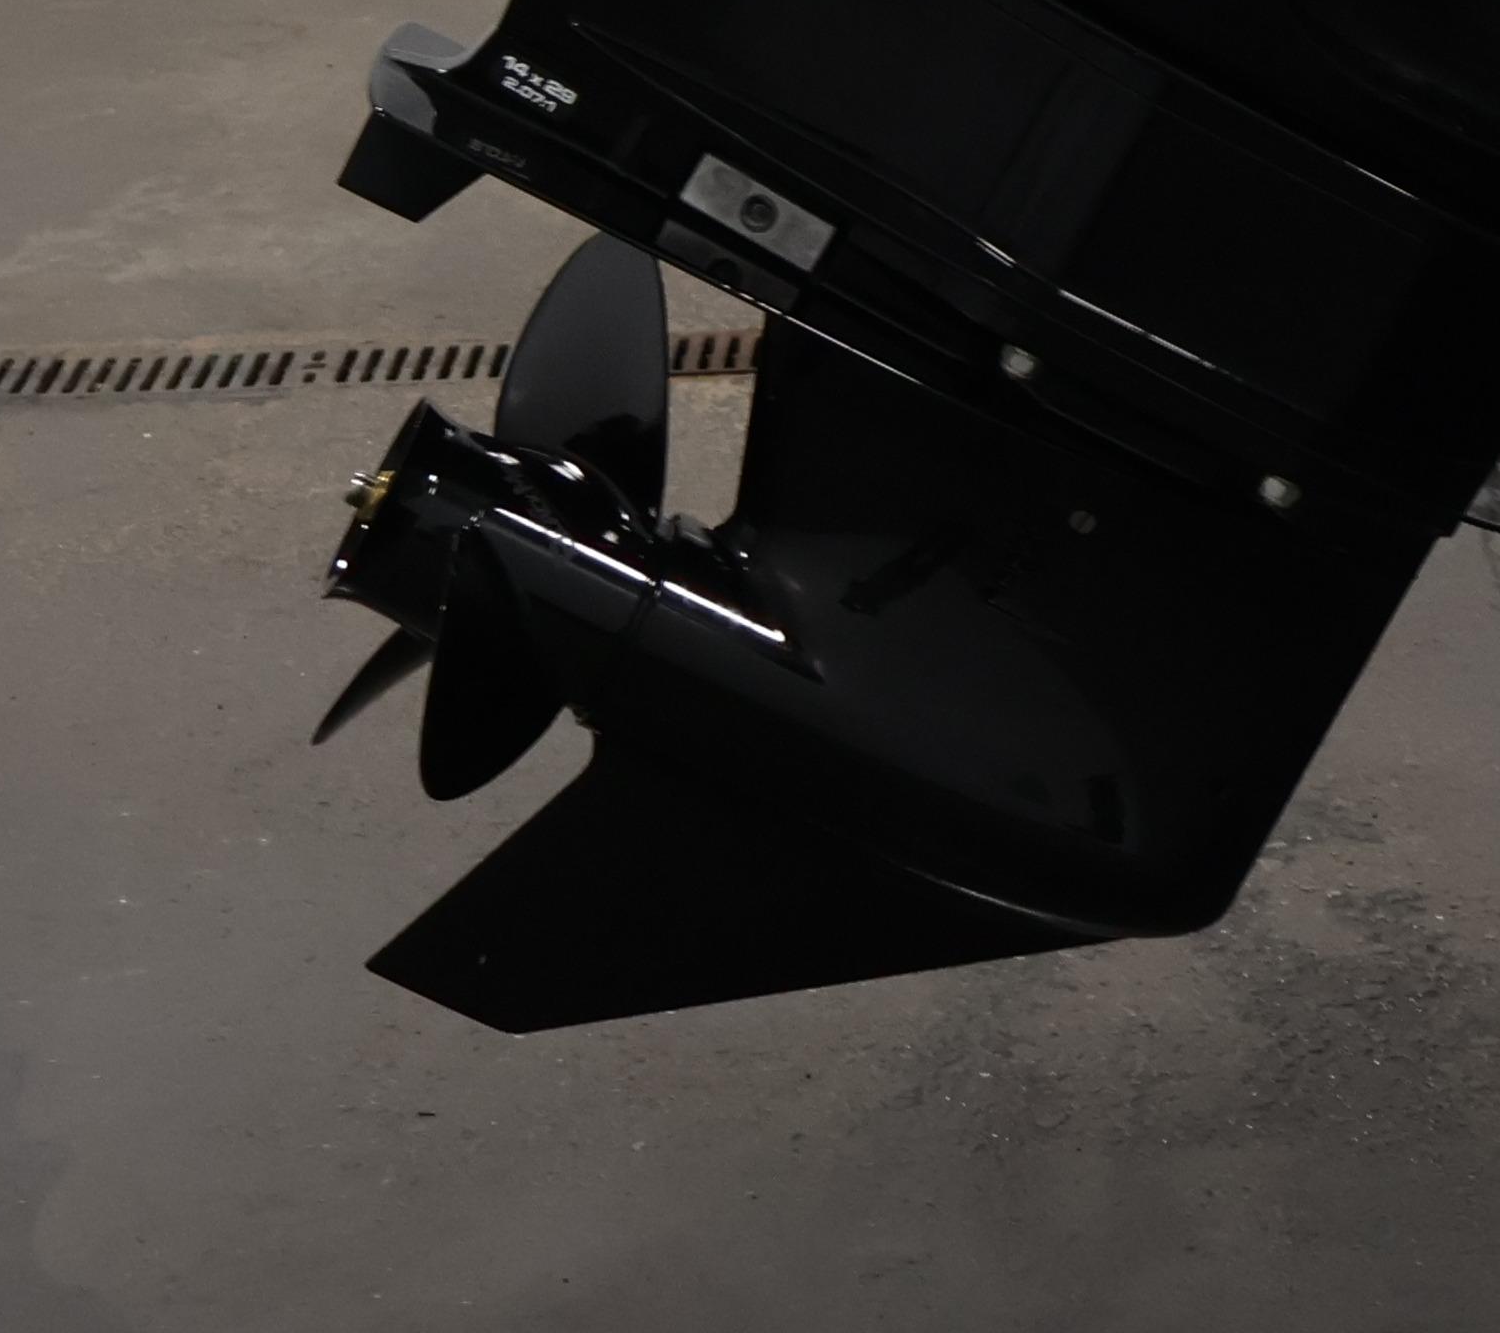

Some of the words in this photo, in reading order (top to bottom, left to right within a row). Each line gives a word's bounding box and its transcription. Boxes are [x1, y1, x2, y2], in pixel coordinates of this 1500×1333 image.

[502, 55, 530, 76] 14
[528, 72, 546, 87] x
[543, 79, 578, 104] 29
